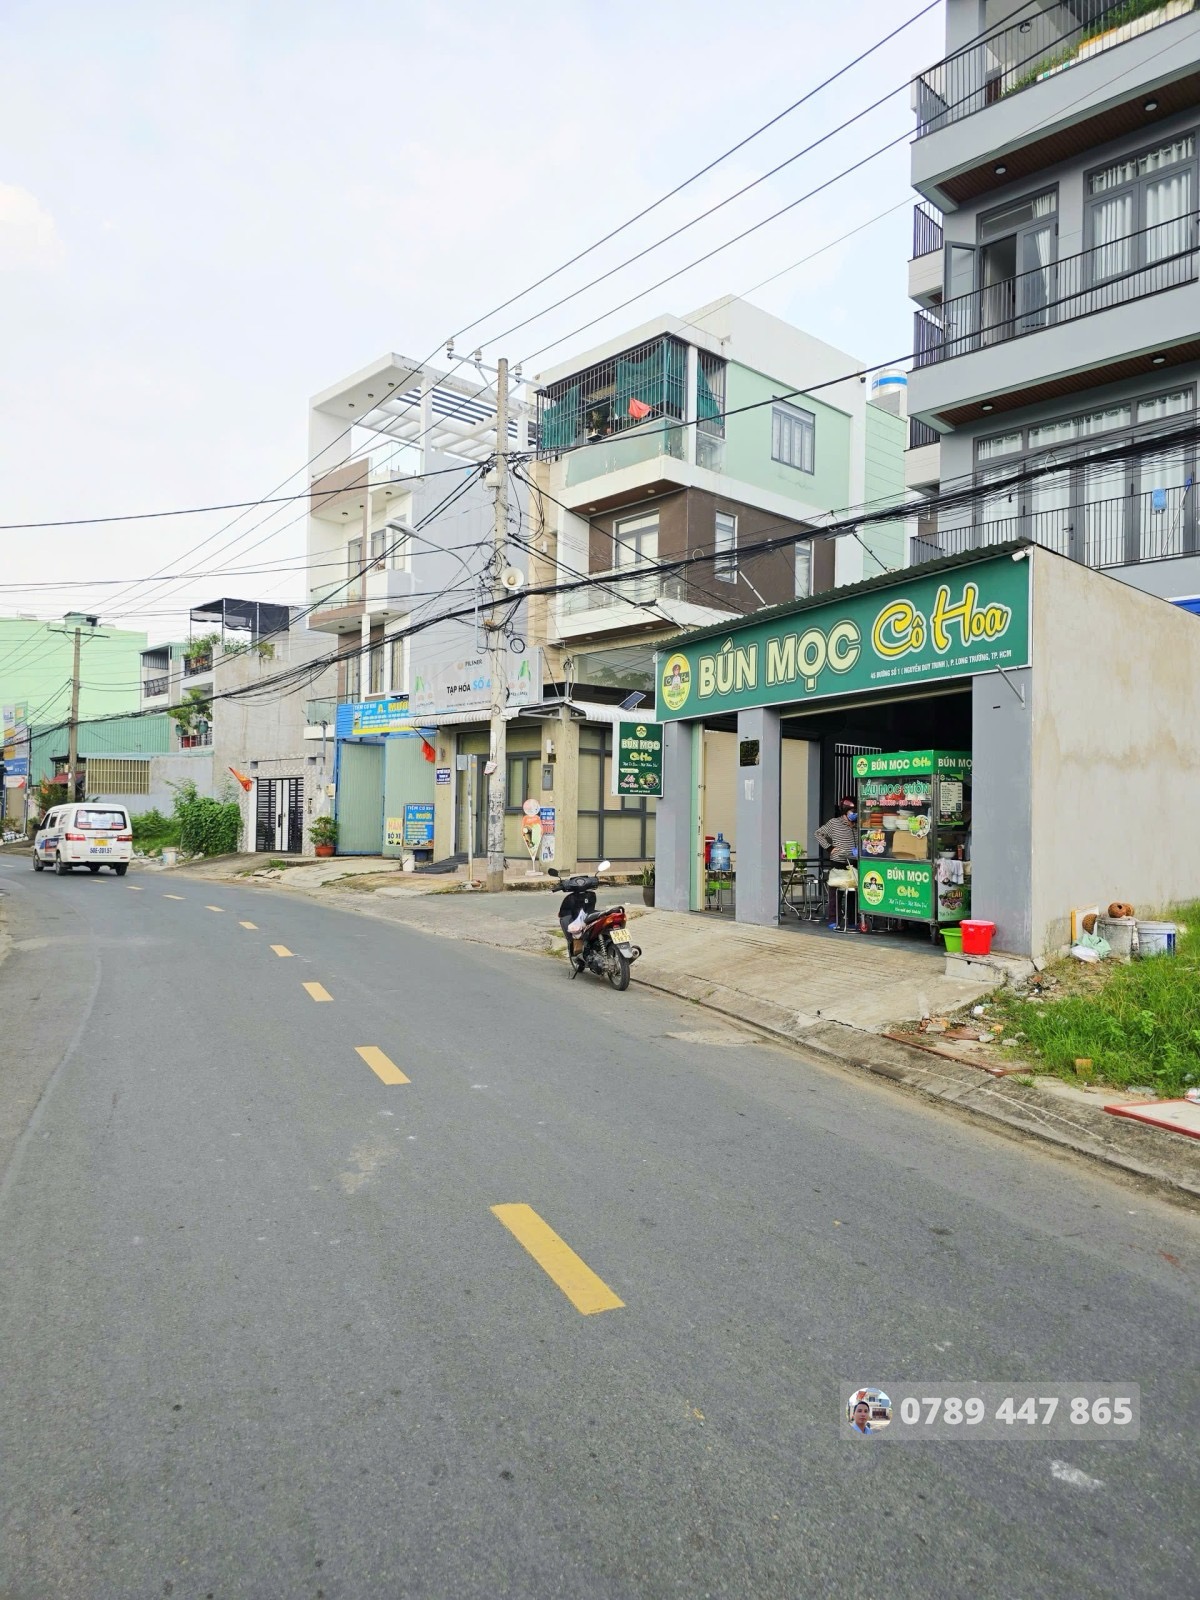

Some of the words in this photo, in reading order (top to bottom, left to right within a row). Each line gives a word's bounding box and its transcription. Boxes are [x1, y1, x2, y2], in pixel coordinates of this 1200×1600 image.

[871, 599, 926, 660] Cô
[931, 582, 1012, 655] Hoa
[698, 638, 758, 699] BÚN
[766, 620, 861, 692] MỌC
[955, 656, 968, 665] LONG
[999, 650, 1012, 658] HCM
[447, 685, 457, 695] TẠP
[458, 682, 471, 693] HÓA
[472, 676, 485, 691] SỐ
[621, 737, 639, 749] BÚN
[871, 758, 888, 771] BÚN
[889, 759, 910, 772] MỌC
[938, 756, 956, 767] BÚN
[861, 779, 878, 796] LẨU
[879, 783, 900, 798] MỌC
[903, 779, 930, 796] SƯỜN
[886, 866, 904, 881] BÚN
[907, 870, 930, 885] MỌC
